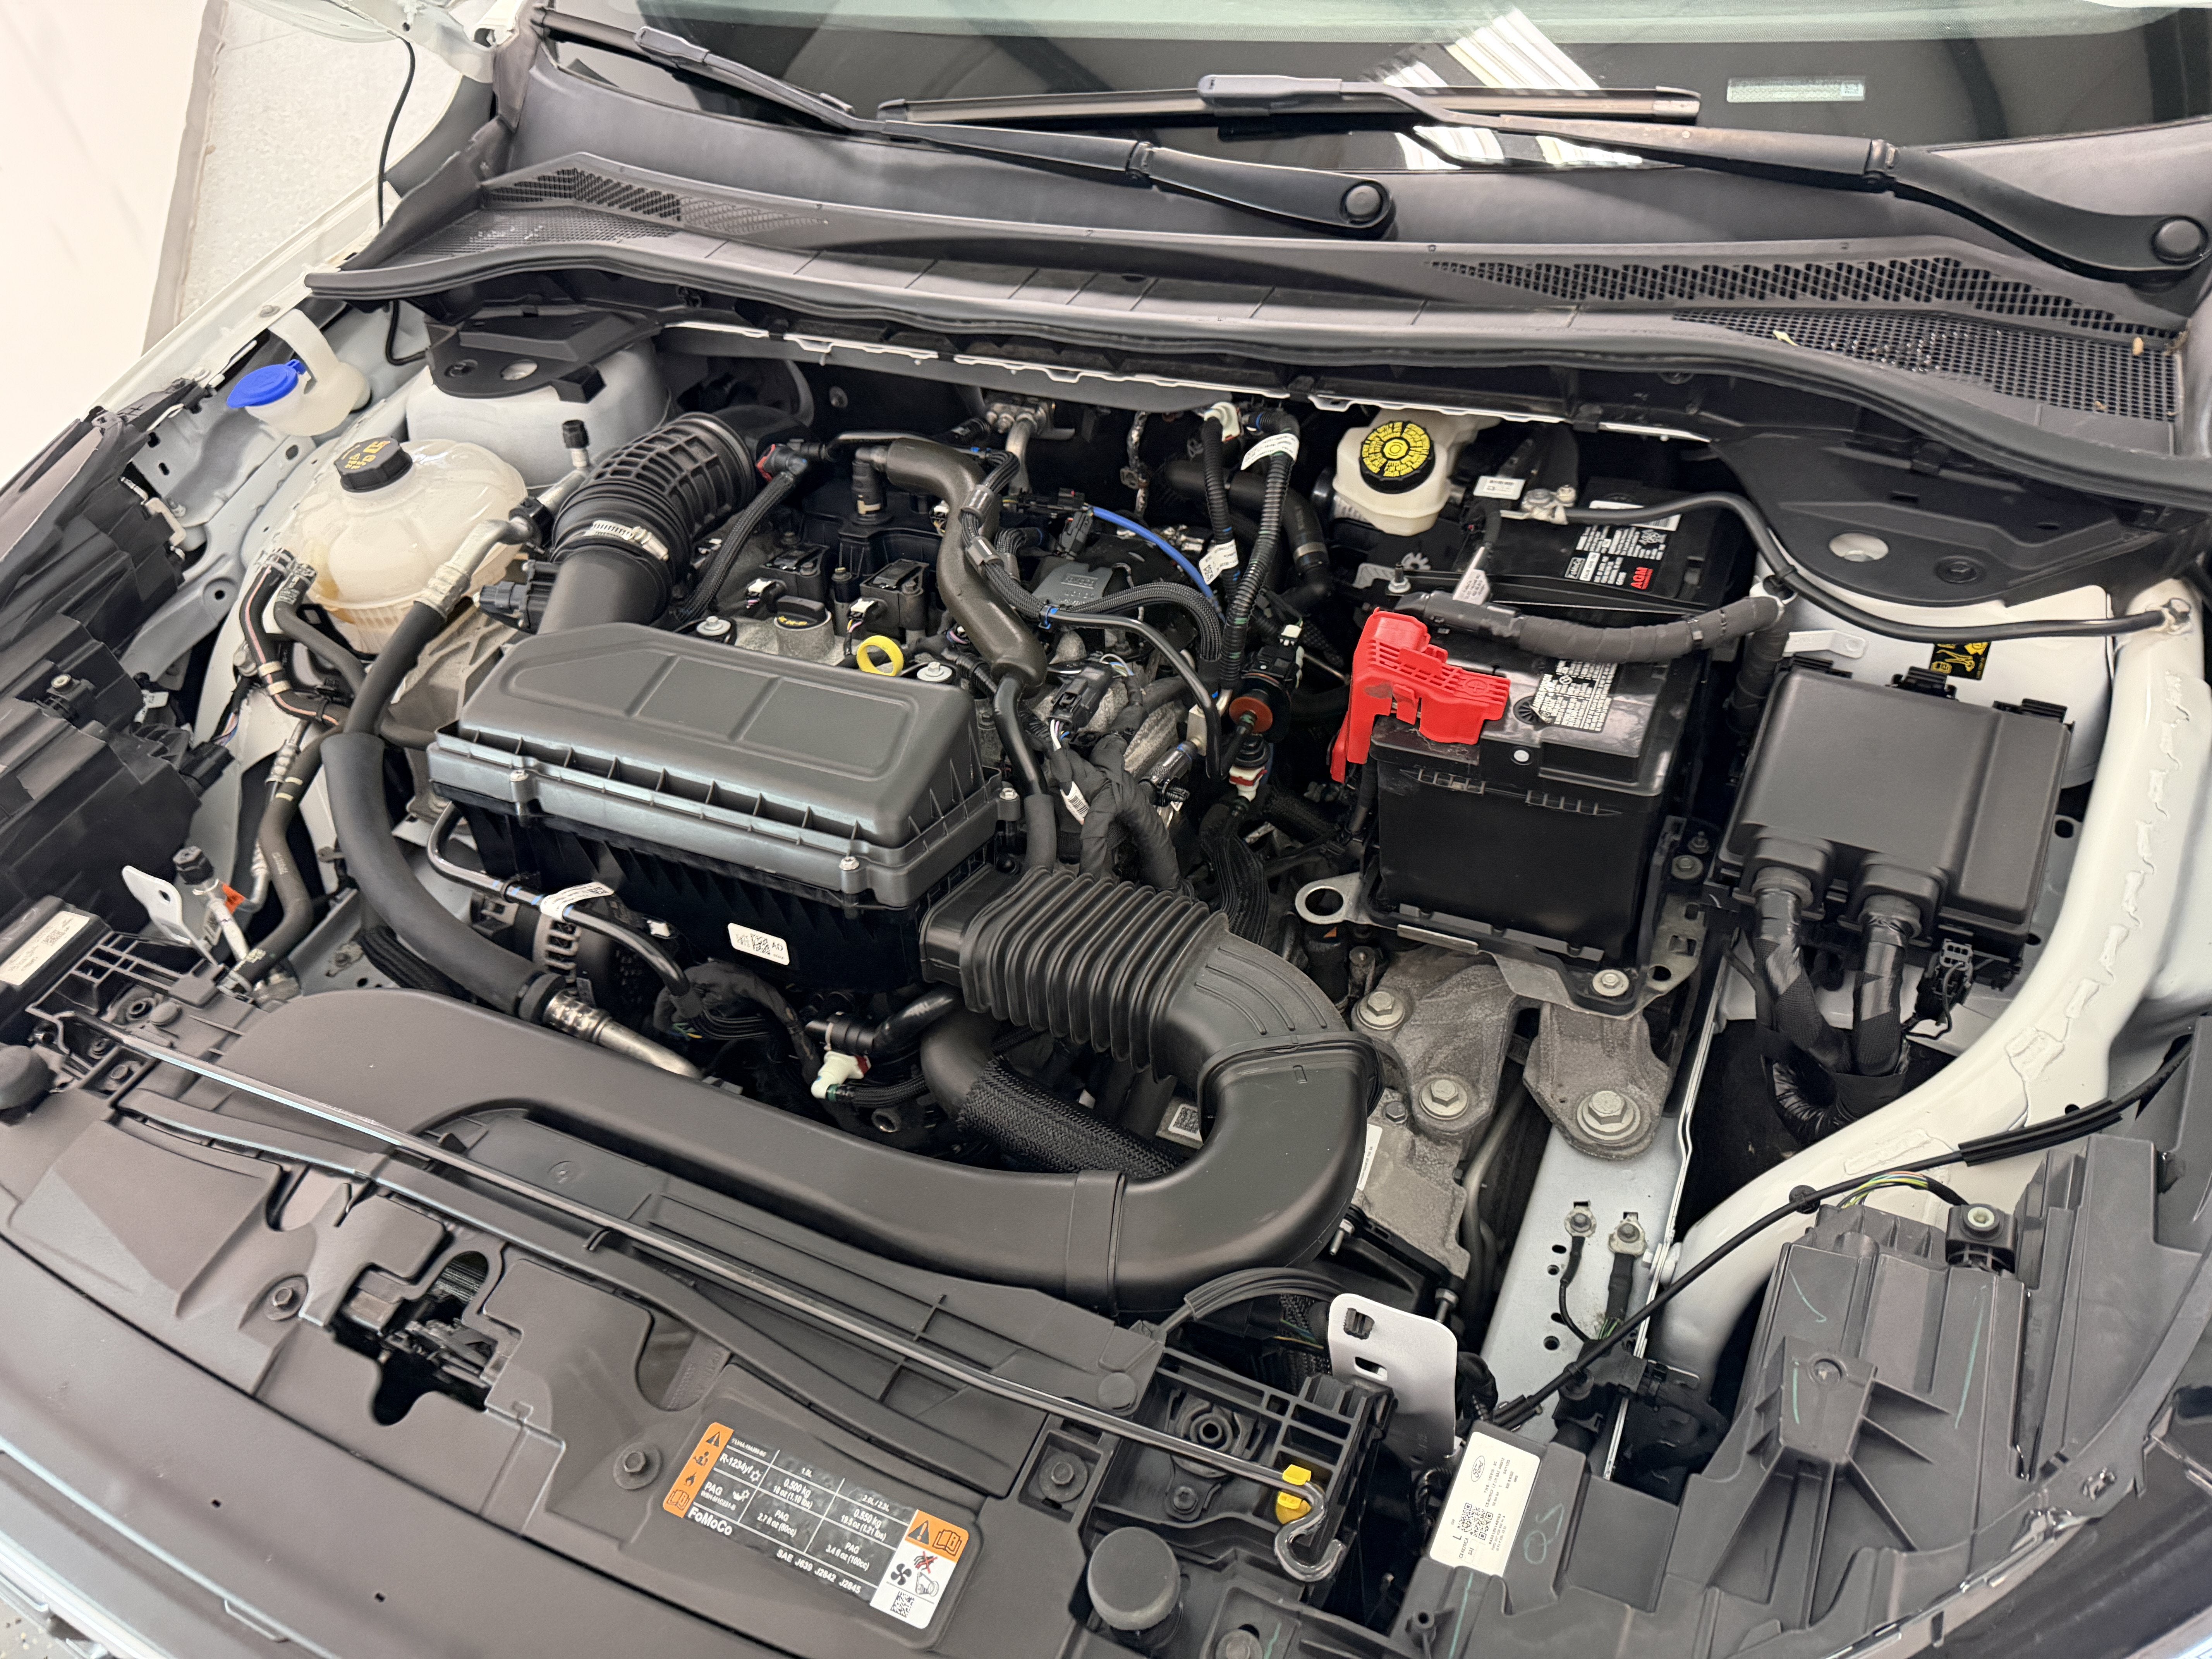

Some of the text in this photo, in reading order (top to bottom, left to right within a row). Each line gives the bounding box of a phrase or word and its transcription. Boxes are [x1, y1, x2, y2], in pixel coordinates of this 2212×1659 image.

[1630, 567, 1649, 589] AGM
[719, 1453, 754, 1474] R-1234yf
[1472, 1460, 1484, 1478] Ford
[704, 1481, 723, 1496] PAG
[780, 1489, 788, 1498] oz
[783, 1478, 811, 1499] 0.500 kg
[688, 1506, 733, 1536] FoMoCo
[757, 1513, 768, 1522] 2.7
[771, 1520, 780, 1528] oz
[775, 1510, 789, 1522] PAG
[853, 1508, 882, 1529] 0.550 kg
[852, 1521, 860, 1529] oz
[859, 1523, 877, 1535] (1.21
[776, 1549, 793, 1563] SAE
[845, 1542, 861, 1554] PAG
[826, 1544, 836, 1554] 3.4
[840, 1552, 848, 1561] oz
[847, 1554, 870, 1571] (100cc)
